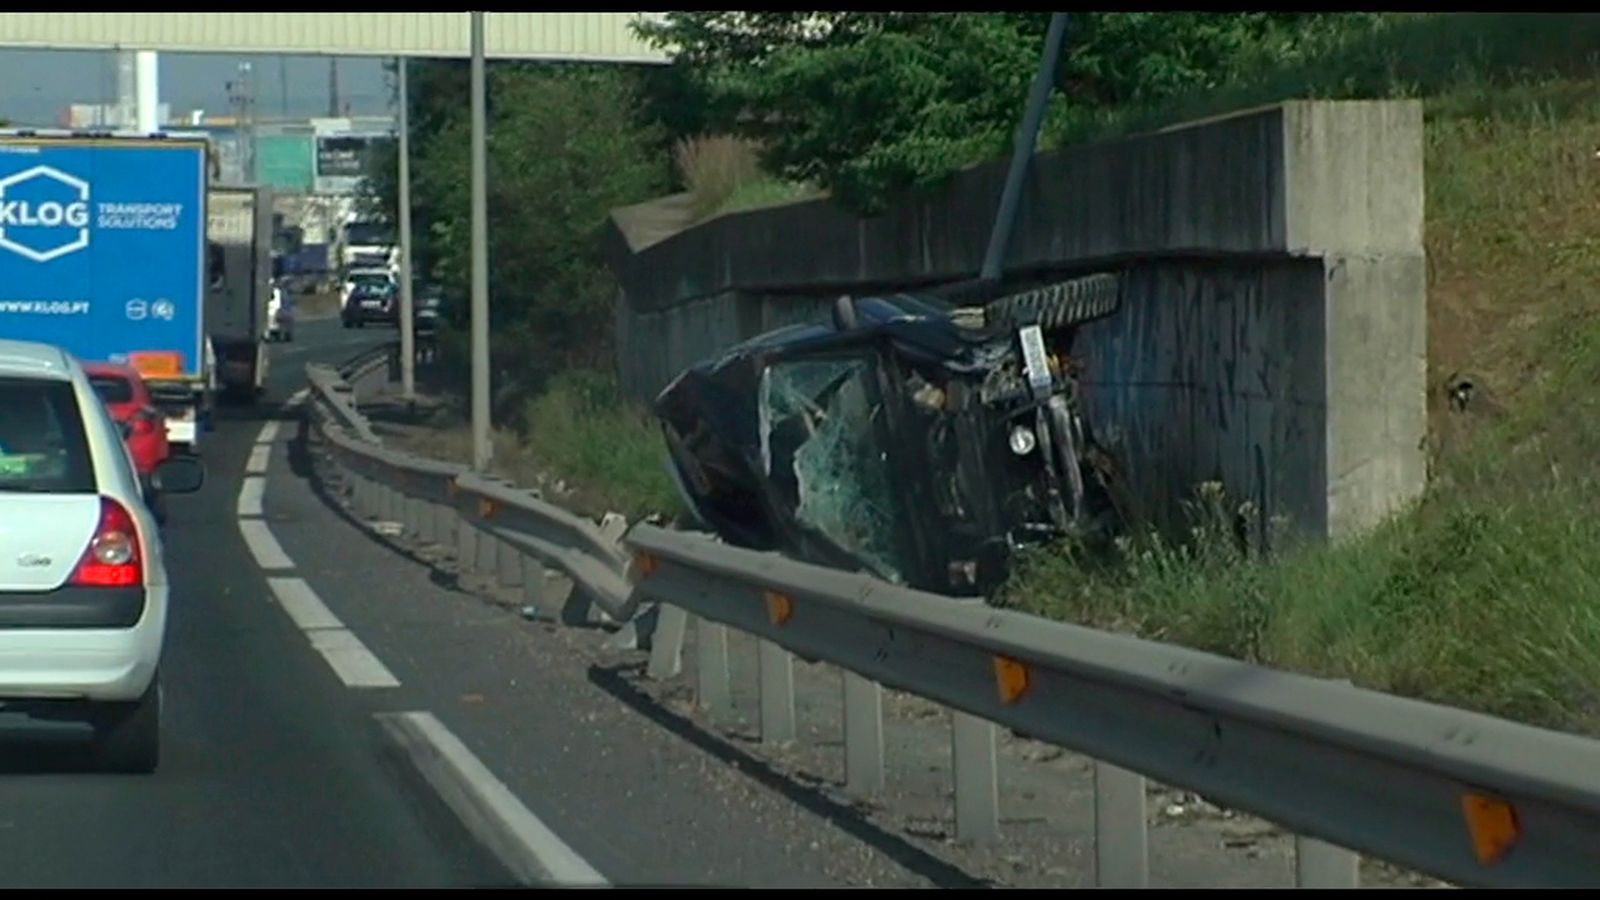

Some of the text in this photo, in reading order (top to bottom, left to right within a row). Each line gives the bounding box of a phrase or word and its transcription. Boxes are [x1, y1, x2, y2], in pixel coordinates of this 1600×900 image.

[0, 200, 89, 226] KLOG
[97, 202, 183, 215] TRANSPORT
[97, 215, 178, 229] SOLUTIONS
